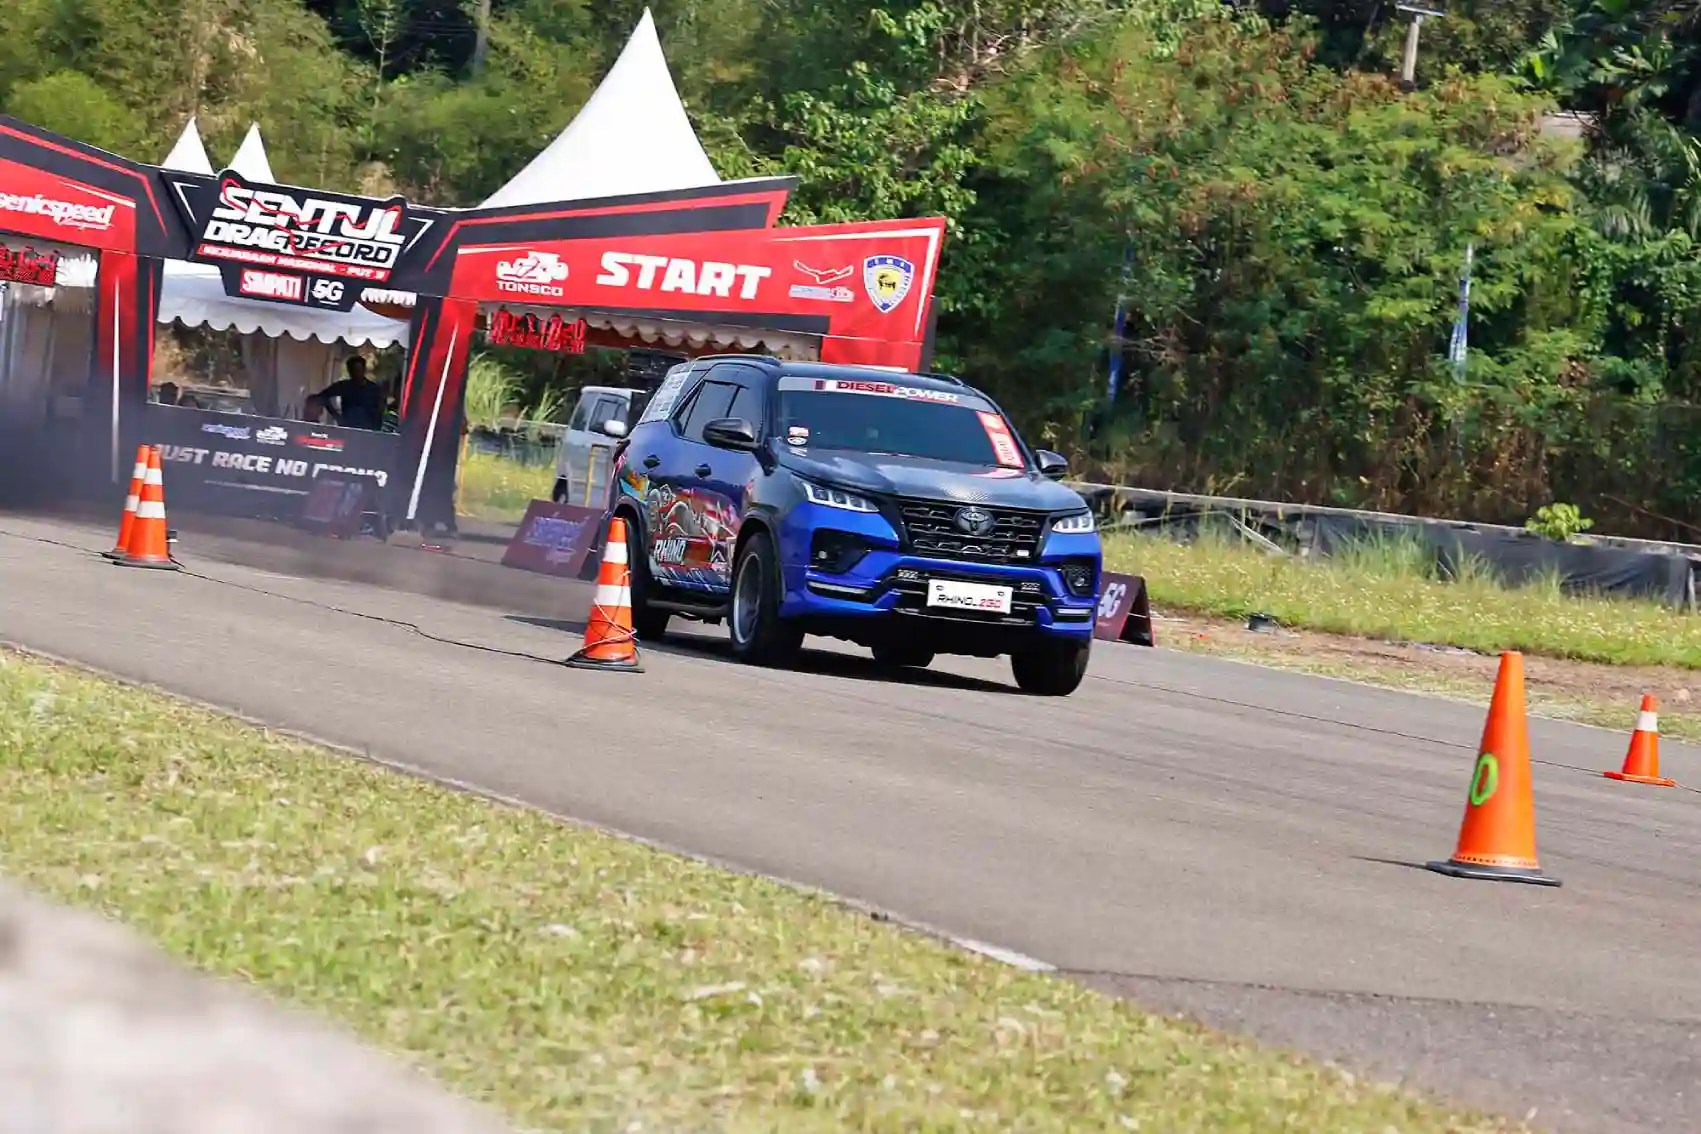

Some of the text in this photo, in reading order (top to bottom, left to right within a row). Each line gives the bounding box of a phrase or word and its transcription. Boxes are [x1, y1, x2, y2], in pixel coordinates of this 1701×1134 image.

[212, 185, 406, 244] SENTUL
[596, 251, 772, 300] START
[312, 278, 344, 301] 5G
[496, 280, 563, 297] TONSCO
[212, 451, 273, 472] RACE
[274, 458, 308, 477] NO
[653, 538, 687, 563] RHINO
